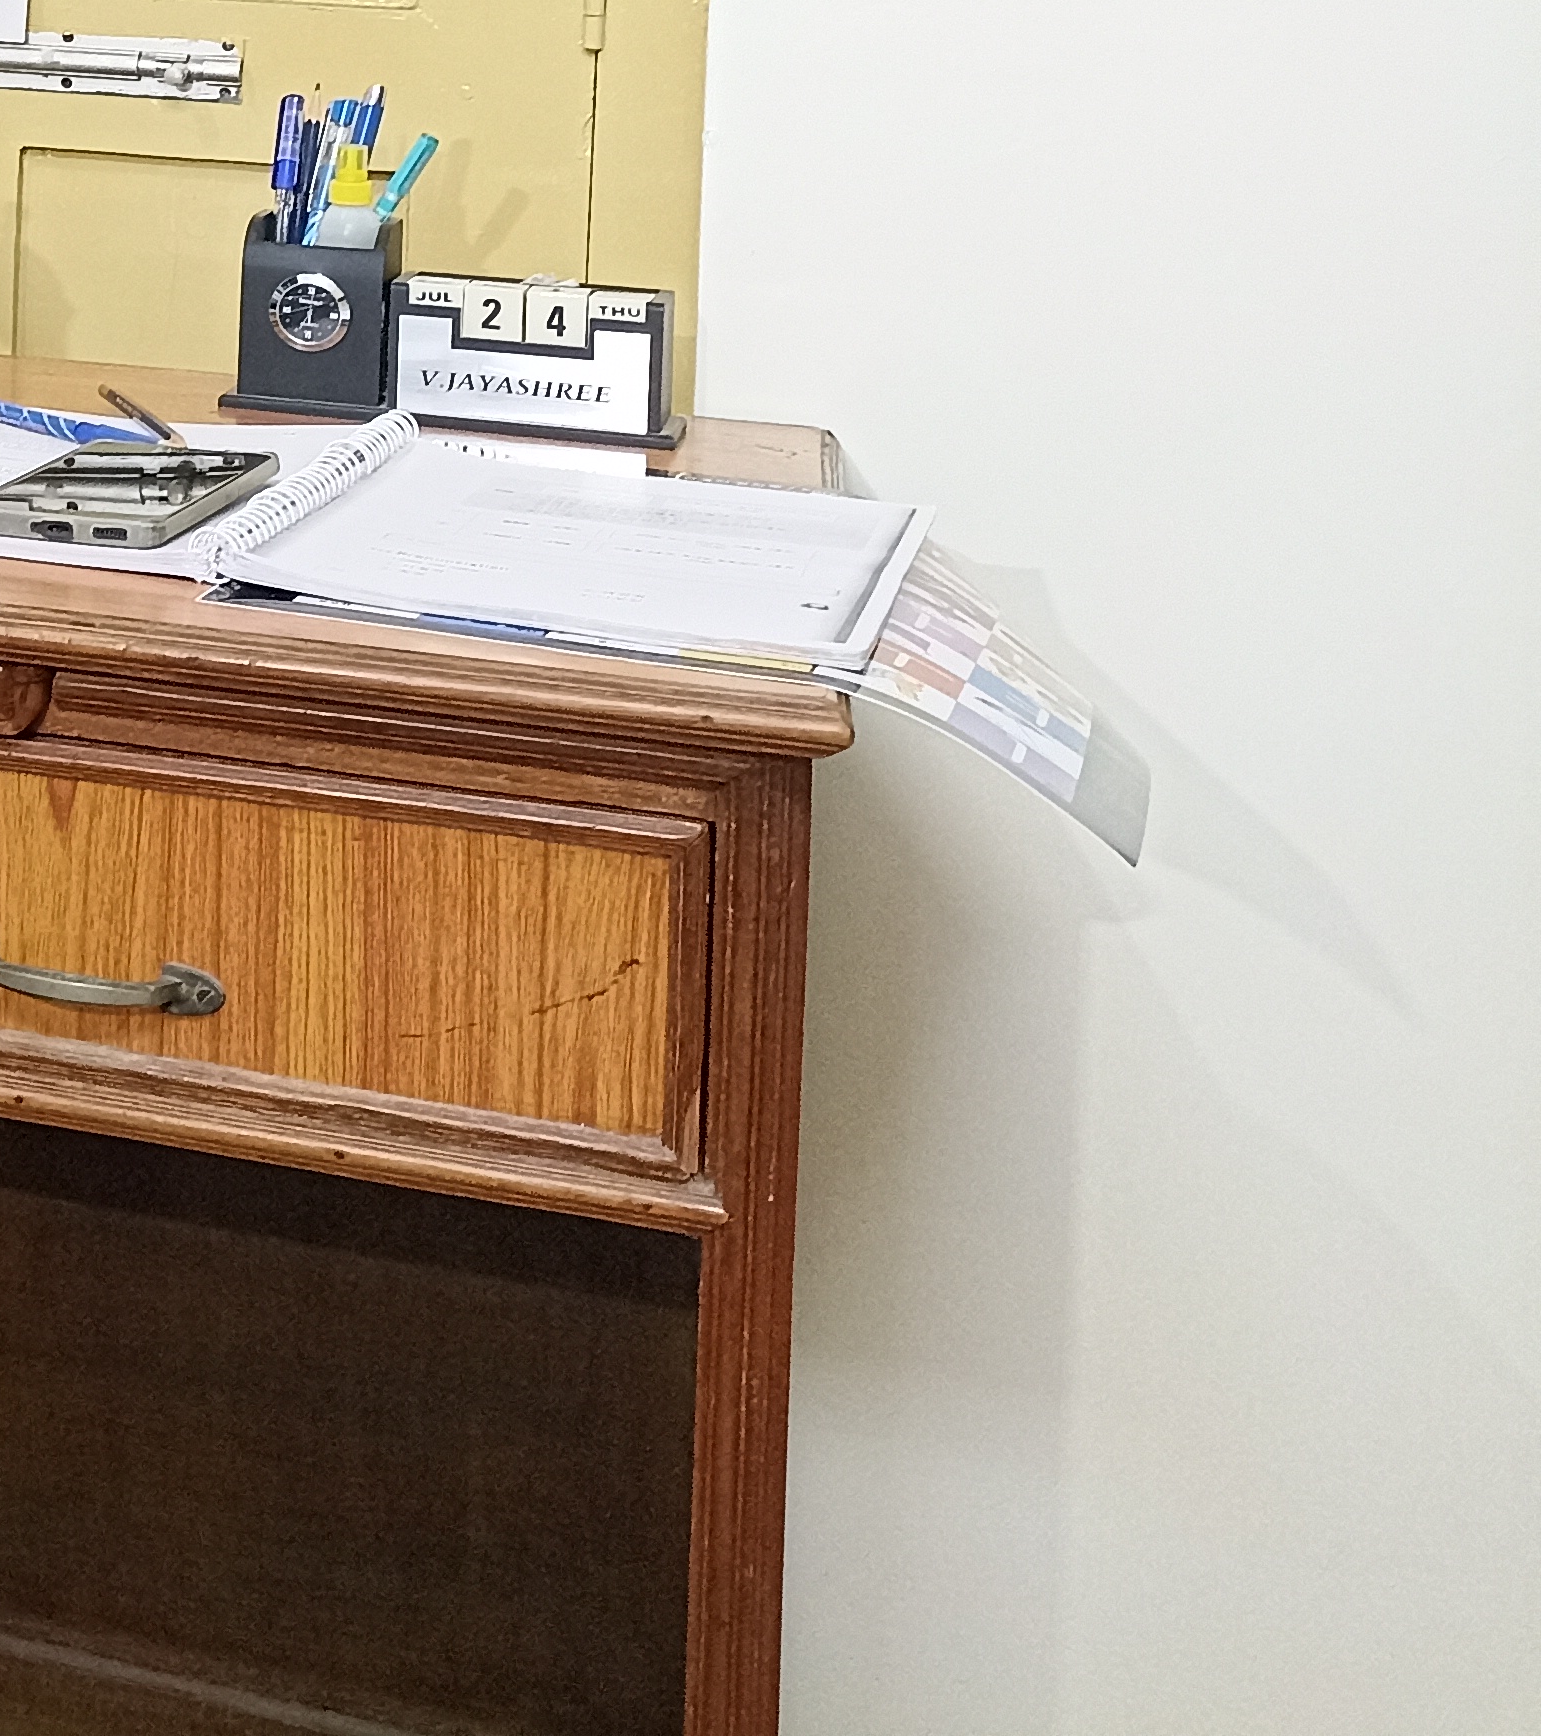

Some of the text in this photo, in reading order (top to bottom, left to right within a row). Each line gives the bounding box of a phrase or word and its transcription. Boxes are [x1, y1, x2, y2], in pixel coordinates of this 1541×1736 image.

[415, 290, 641, 338] JUL 2 4 THU
[420, 369, 612, 404] V.JAYASHREE
